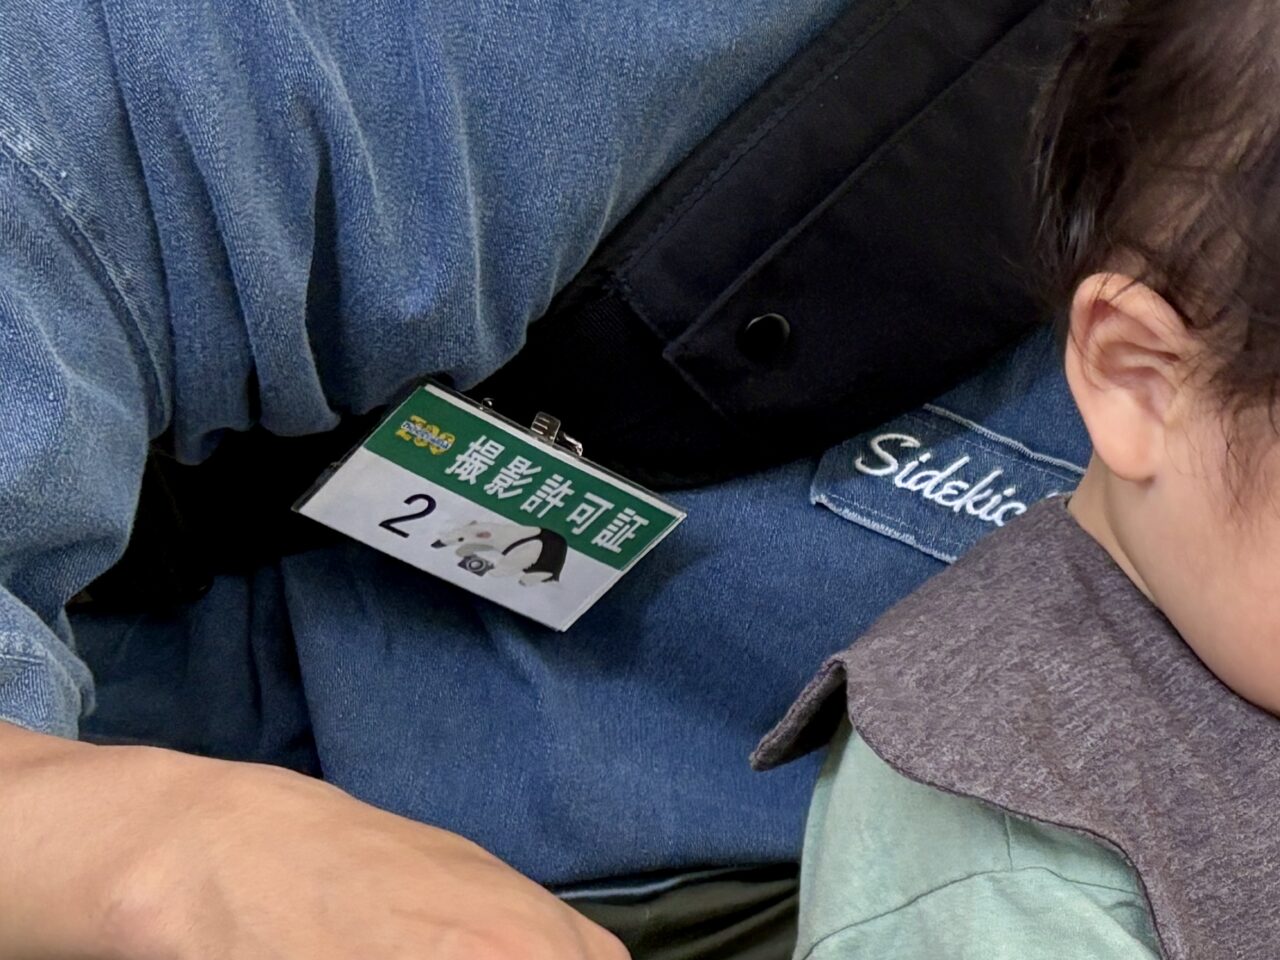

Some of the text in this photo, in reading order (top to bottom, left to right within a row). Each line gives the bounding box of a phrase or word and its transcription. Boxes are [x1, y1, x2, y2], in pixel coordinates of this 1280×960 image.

[378, 493, 437, 538] 2
[444, 434, 651, 553] 撮影許可証
[855, 433, 1058, 527] Sidekic
